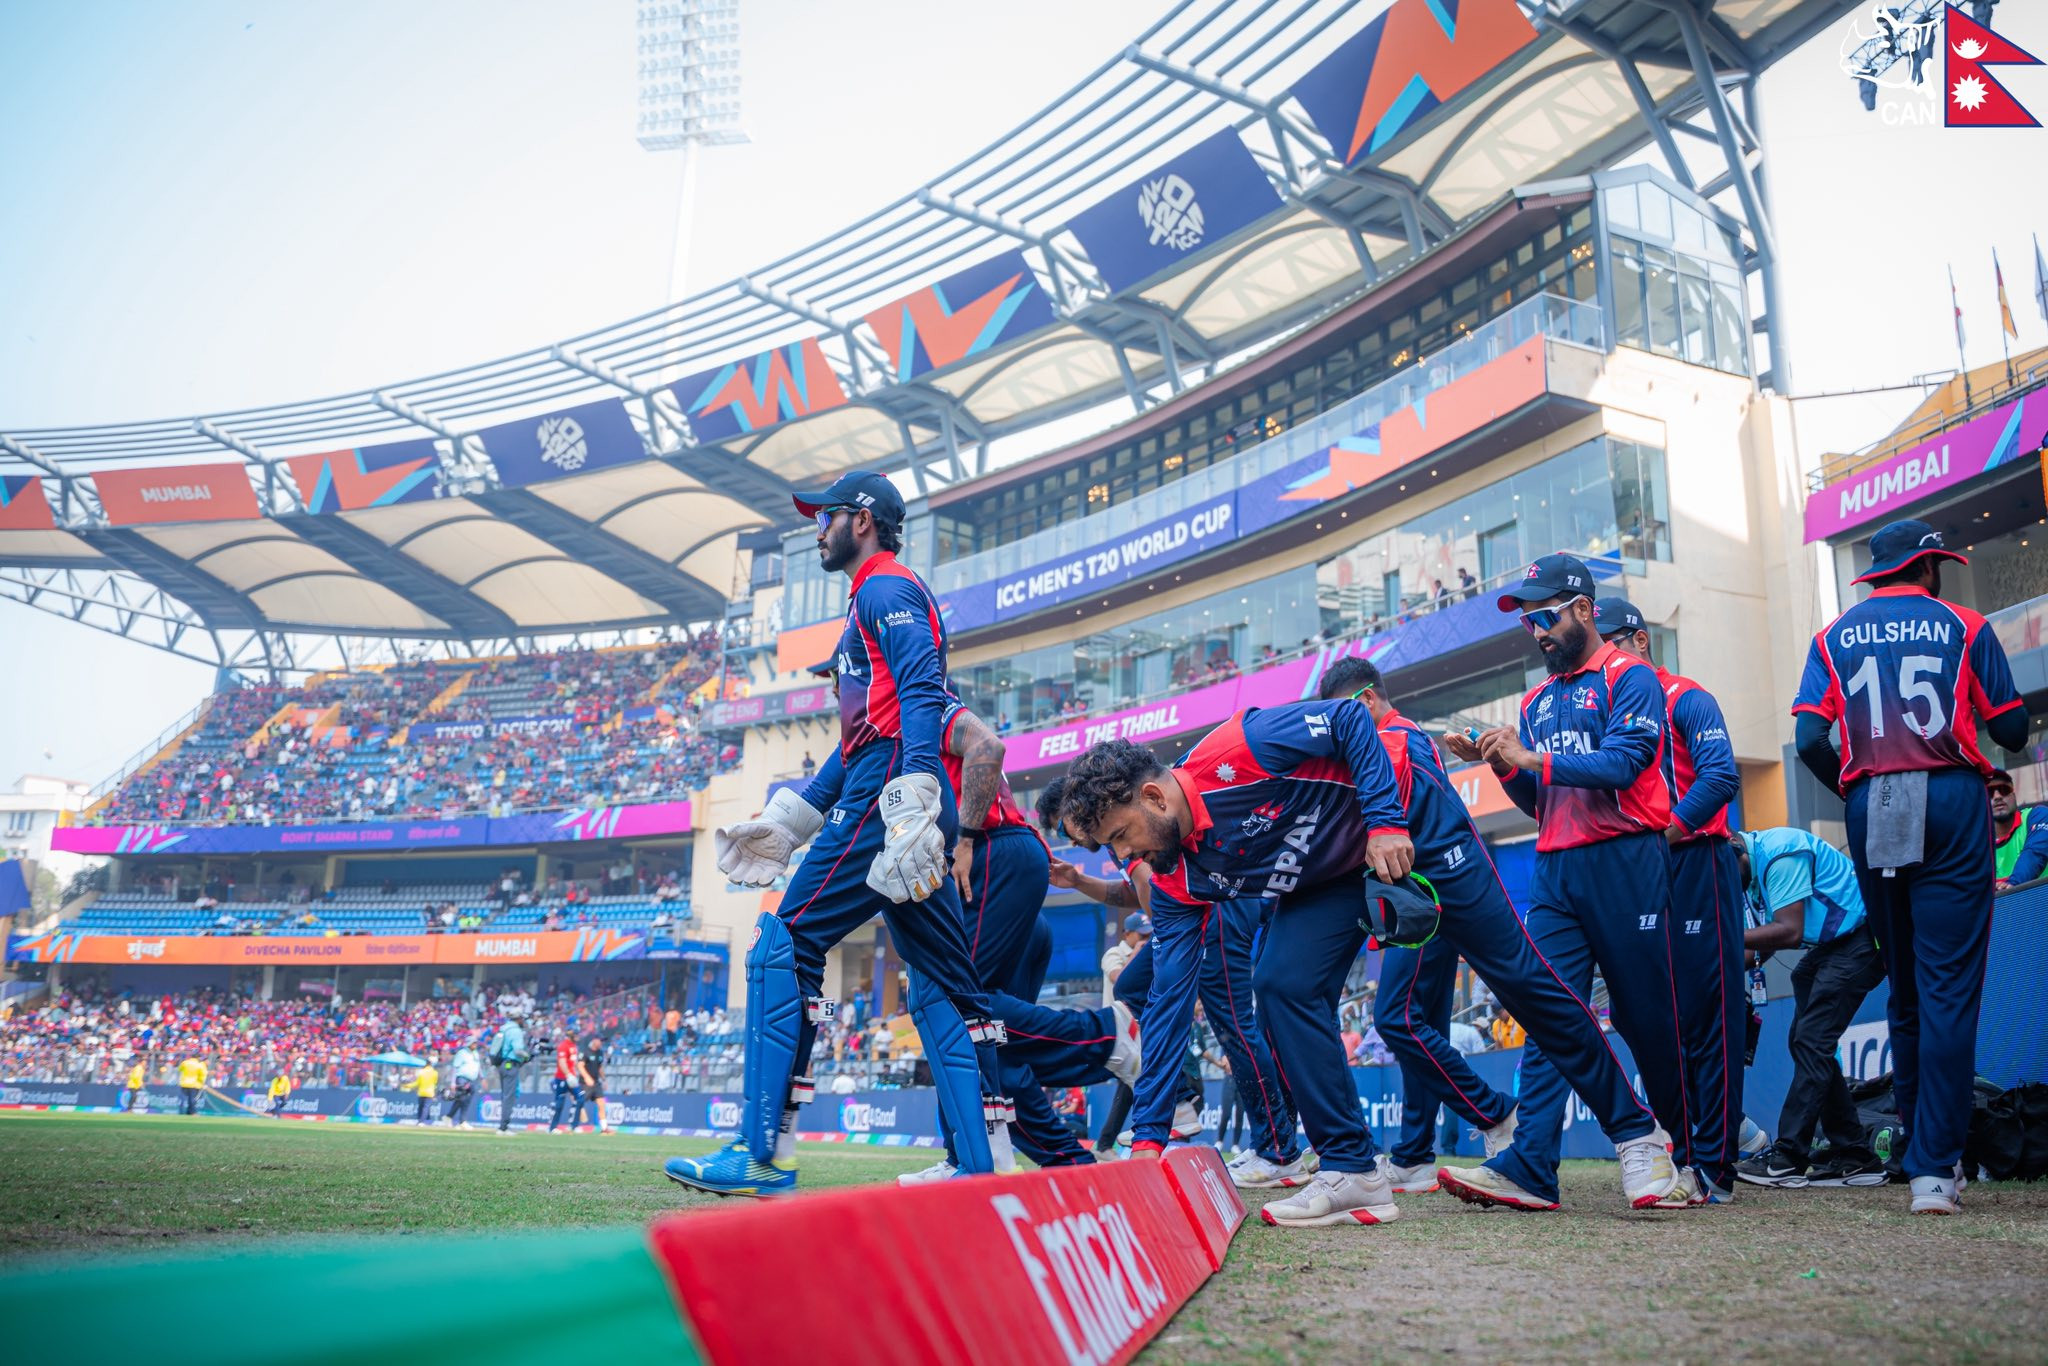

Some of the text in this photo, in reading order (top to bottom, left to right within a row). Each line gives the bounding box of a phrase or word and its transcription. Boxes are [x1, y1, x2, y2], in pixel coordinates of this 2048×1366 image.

[140, 484, 211, 503] MUMBAI
[1839, 444, 1949, 519] MUMBAI
[996, 503, 1232, 610] ICC MEN'S T20 WORLD CUP
[1840, 619, 1950, 648] GULSHAN
[1847, 654, 1946, 740] 15
[1038, 704, 1180, 759] FEEL THE THRILL
[1535, 730, 1600, 756] NEPAL
[888, 790, 902, 807] SS
[281, 831, 314, 843] ROHIT
[315, 830, 358, 843] SHARMA
[360, 829, 394, 842] STAND
[245, 944, 342, 956] DIVECHA PAVILION
[475, 939, 537, 957] MUMBAI
